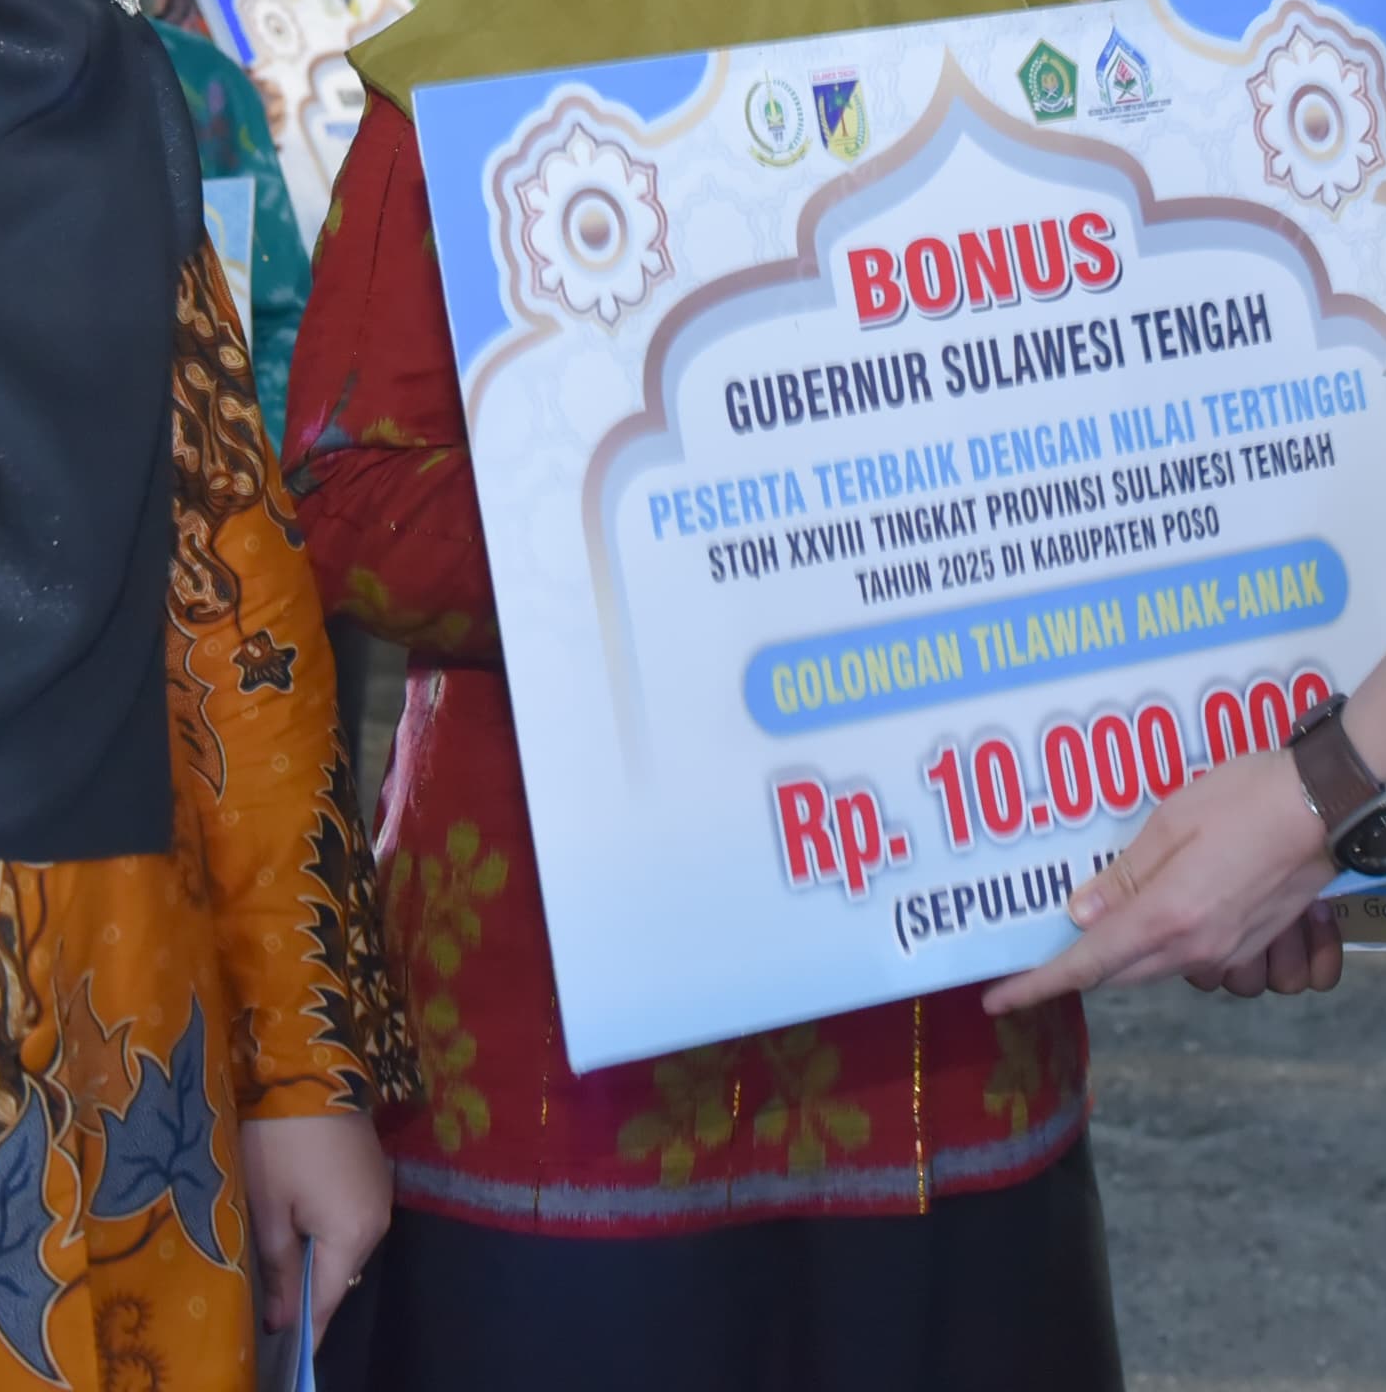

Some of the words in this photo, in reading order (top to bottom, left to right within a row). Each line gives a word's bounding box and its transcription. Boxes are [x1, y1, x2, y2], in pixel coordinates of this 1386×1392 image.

[847, 211, 1121, 328] BONUS
[725, 351, 934, 436] GUBERNUR
[942, 318, 1125, 396] SULAWESI
[1131, 293, 1272, 363] TENGAH
[648, 467, 806, 540] PESERTA
[813, 442, 961, 509] TERBAIK
[967, 416, 1102, 481] DENGAN
[1109, 400, 1196, 456] NILAI
[1202, 369, 1366, 439] TERTINGGI
[707, 535, 779, 583] STQH
[786, 518, 865, 568] XXVIII
[870, 498, 977, 551] TINGKAT
[986, 474, 1105, 530] PROVINSI
[1112, 451, 1235, 506] SULAWESI
[1239, 432, 1335, 481] TENGAH
[855, 560, 932, 606] TAHUN
[939, 549, 995, 590] 2025
[1001, 542, 1025, 576] DI
[1031, 517, 1157, 571] KABUPATEN
[1162, 506, 1221, 546] POSO
[771, 632, 962, 715] GOLONGAN
[970, 601, 1125, 673] TILAWAH
[1138, 561, 1324, 640] ANAK-ANAK
[776, 779, 908, 894] Rp.
[892, 861, 1074, 954] (SEPULUH
